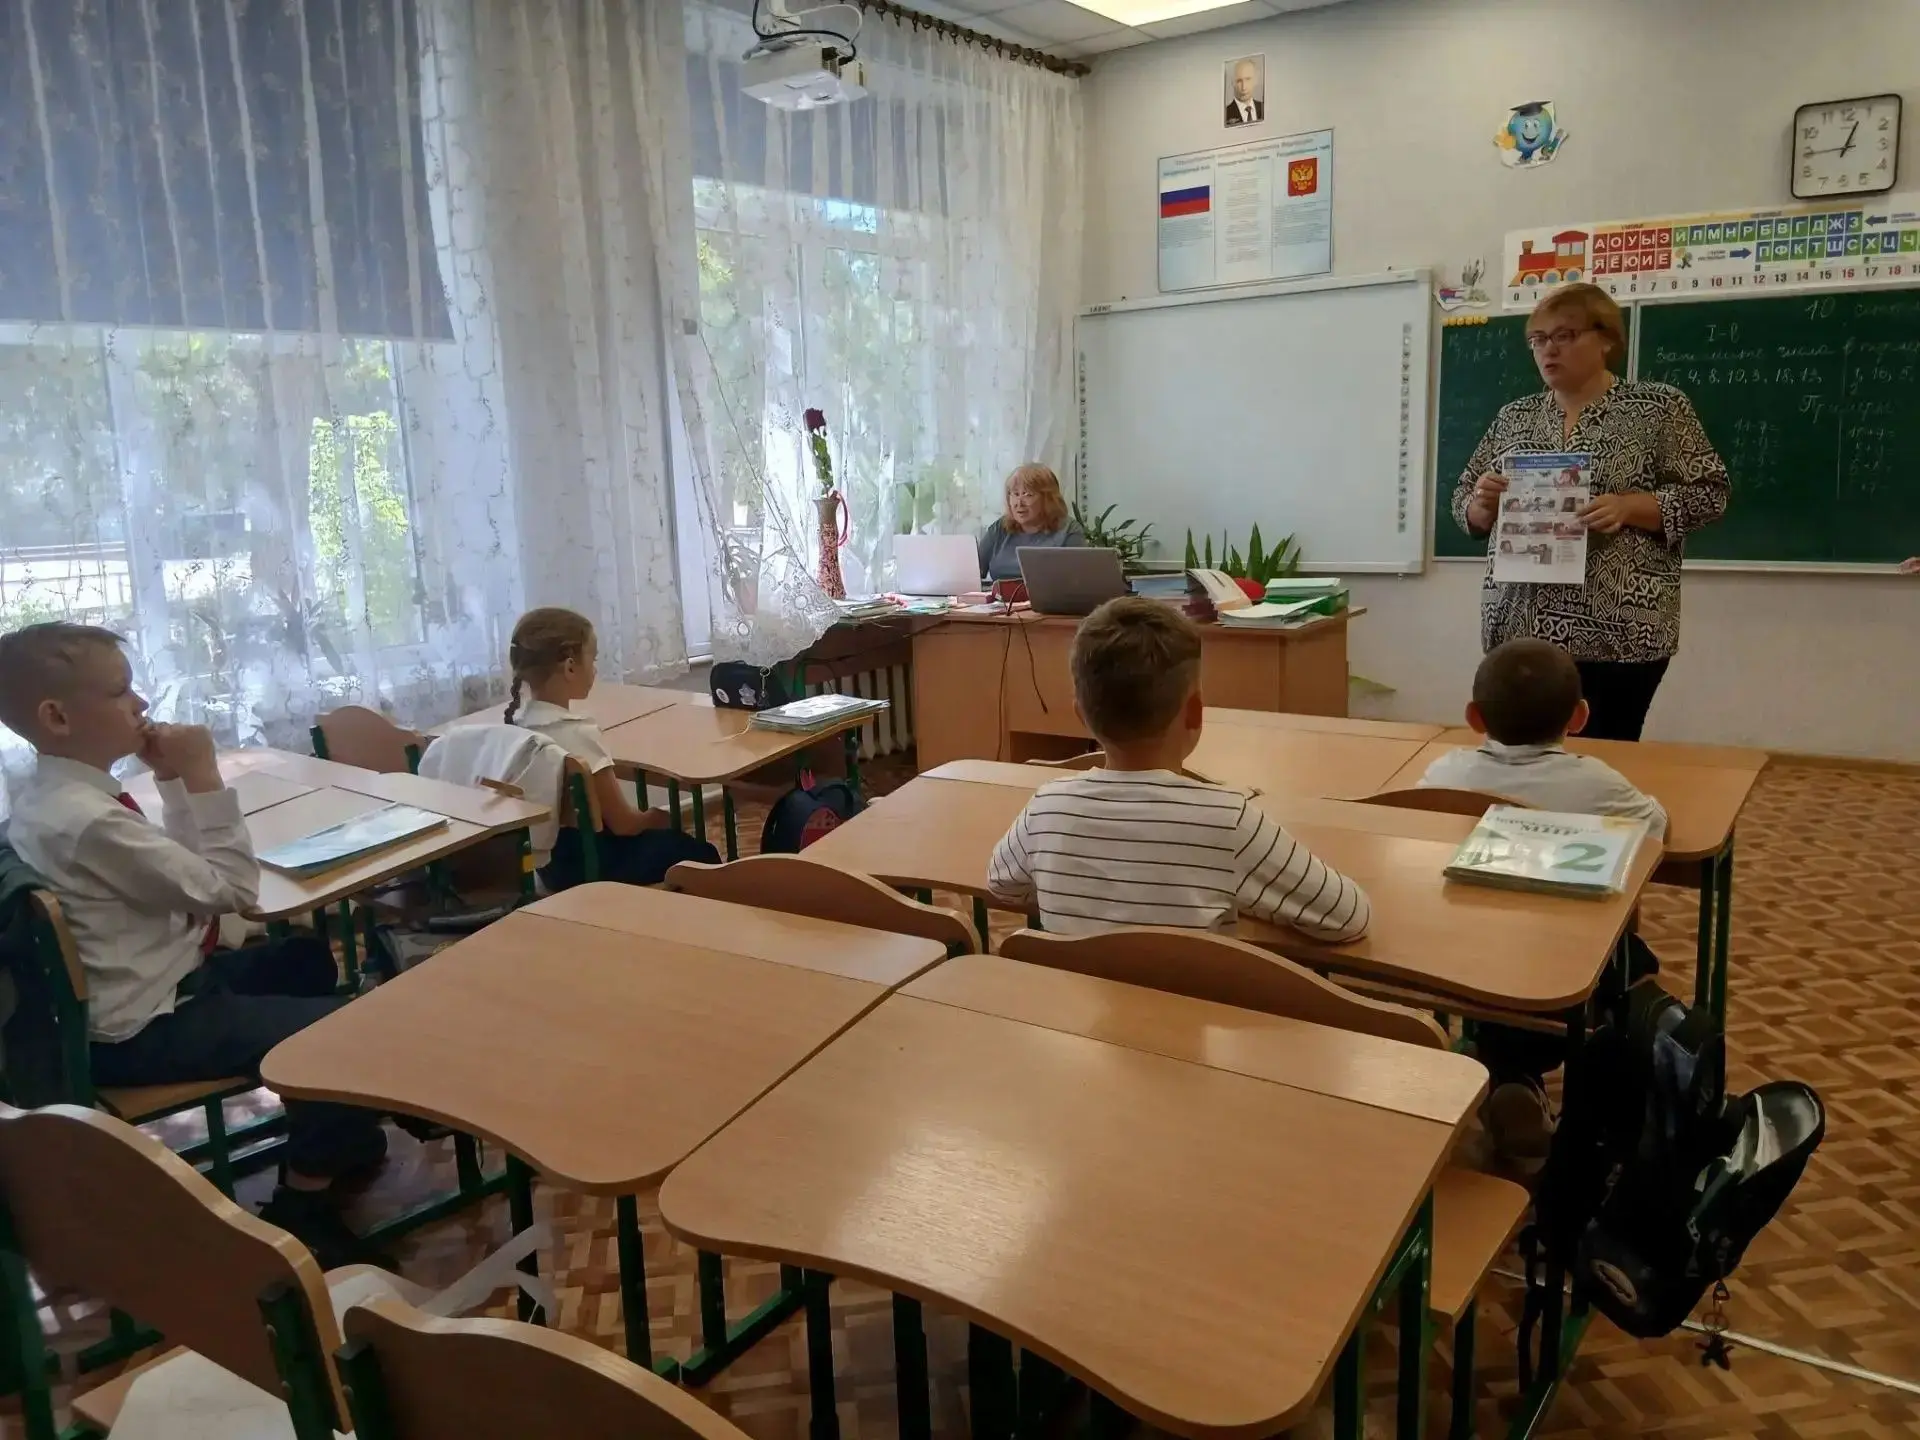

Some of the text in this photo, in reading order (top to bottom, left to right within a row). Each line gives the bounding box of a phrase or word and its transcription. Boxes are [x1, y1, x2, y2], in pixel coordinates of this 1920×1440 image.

[1841, 107, 1855, 121] 12
[1878, 118, 1889, 131] 2
[1552, 842, 1608, 873] 2
